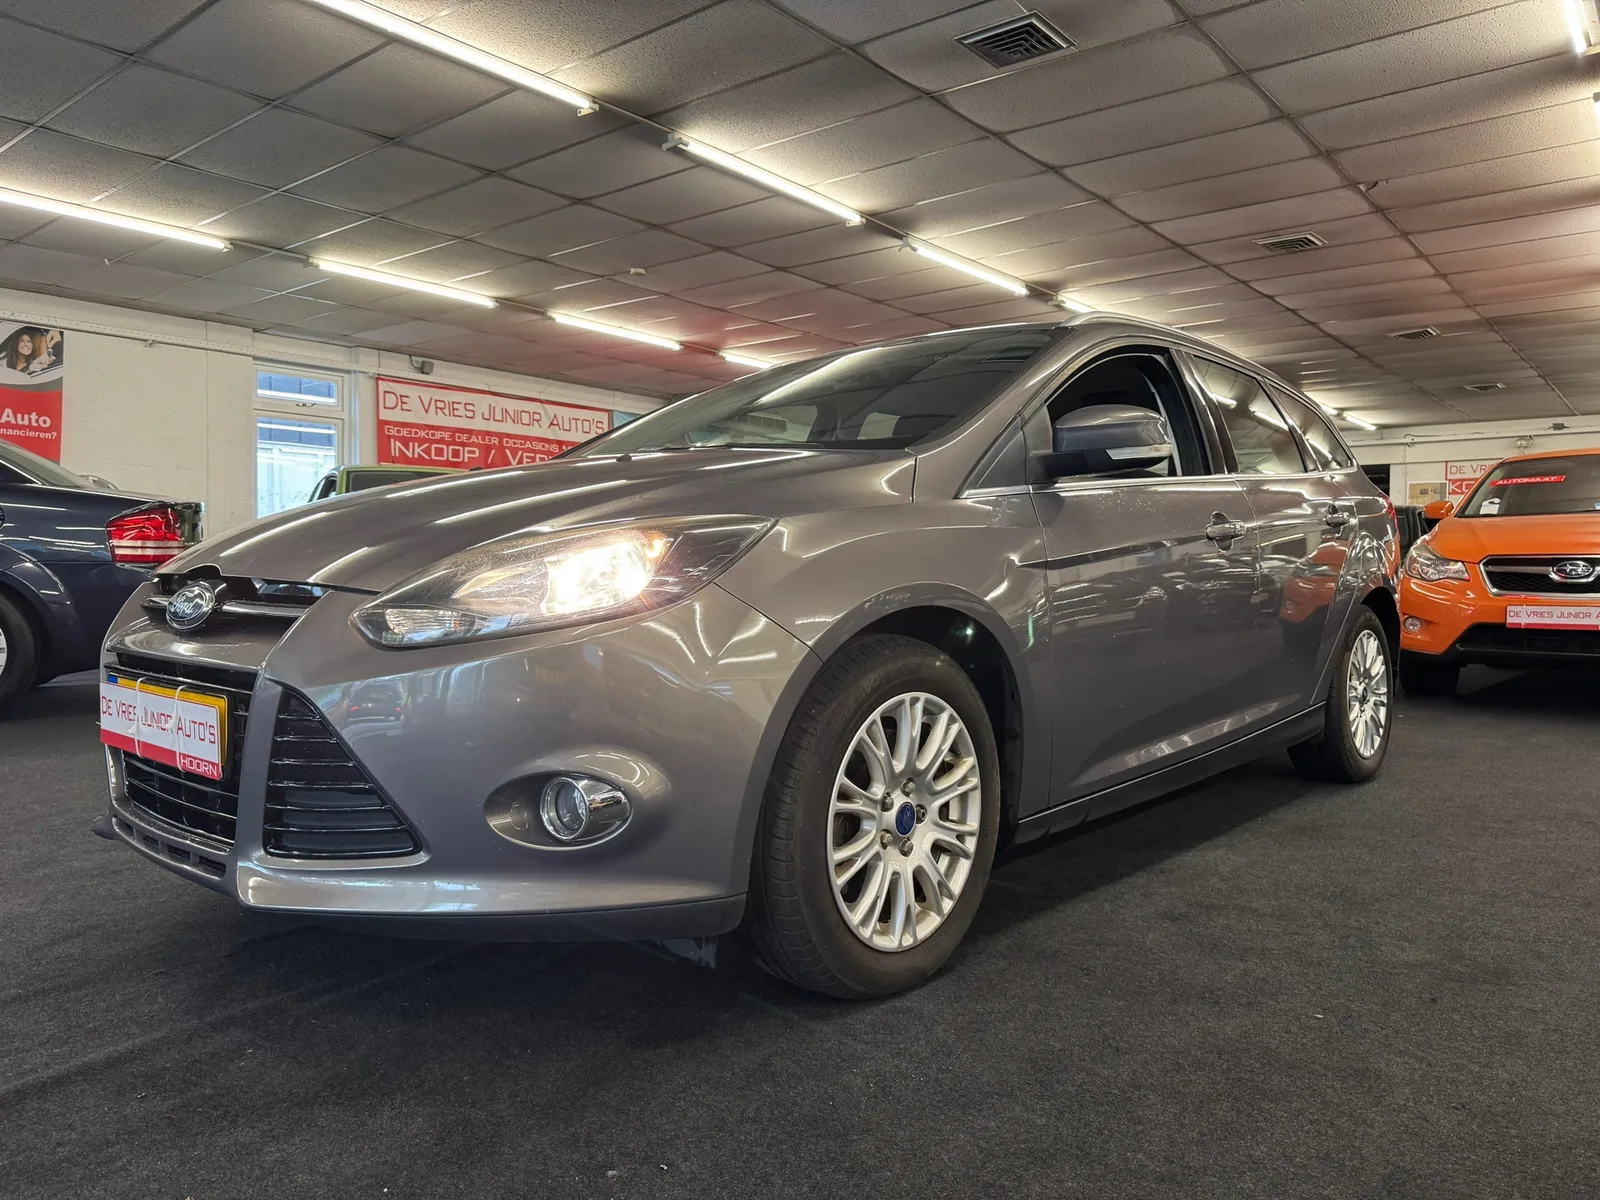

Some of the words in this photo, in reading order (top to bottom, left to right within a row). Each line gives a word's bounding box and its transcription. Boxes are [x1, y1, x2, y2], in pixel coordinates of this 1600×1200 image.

[0, 407, 51, 428] Auto
[383, 390, 412, 413] DE
[418, 395, 476, 420] VRIES
[481, 403, 542, 429] JUNIOR
[547, 413, 605, 435] AUTO'S
[0, 427, 58, 440] nancieren?
[384, 425, 453, 441] GOEDKOPE
[455, 432, 499, 446] DEALER
[502, 437, 559, 453] OCCASIONS
[390, 438, 480, 463] INKOOP
[1449, 465, 1466, 475] DE
[1495, 475, 1558, 486] AUTOMAAT
[1508, 610, 1522, 618] DE
[1525, 611, 1553, 619] VRIES
[1556, 611, 1592, 619] JUNIOR
[101, 695, 113, 717] DE
[177, 715, 217, 745] AUTO'S
[180, 754, 218, 777] HOORN
